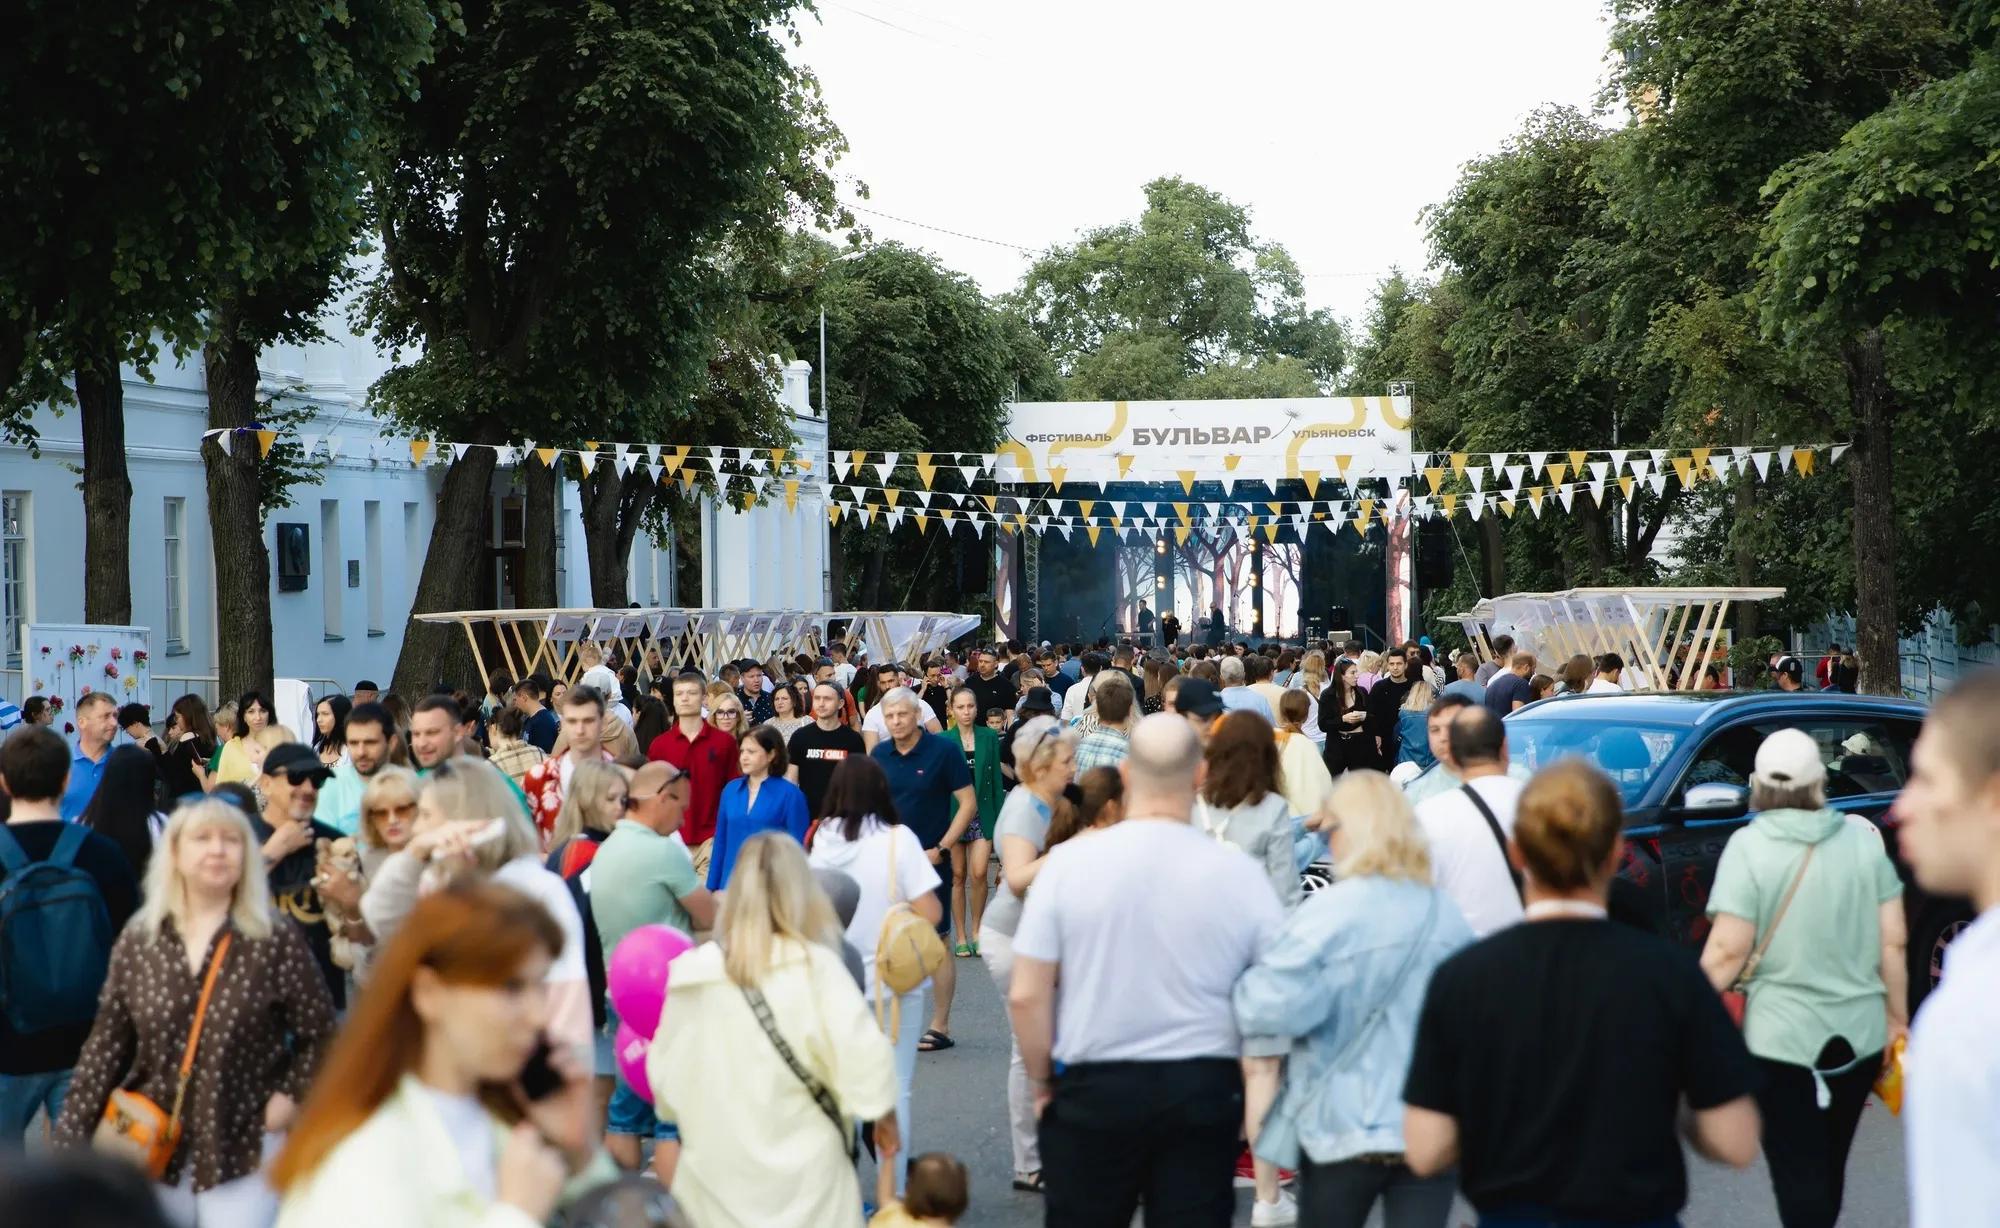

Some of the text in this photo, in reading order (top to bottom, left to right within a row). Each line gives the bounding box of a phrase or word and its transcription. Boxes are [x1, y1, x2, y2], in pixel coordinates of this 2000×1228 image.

[1025, 427, 1376, 447] ФЕСТИВАЛЬ БУЛЬВАР УЛЬЯНОВСК
[806, 748, 825, 759] JUST
